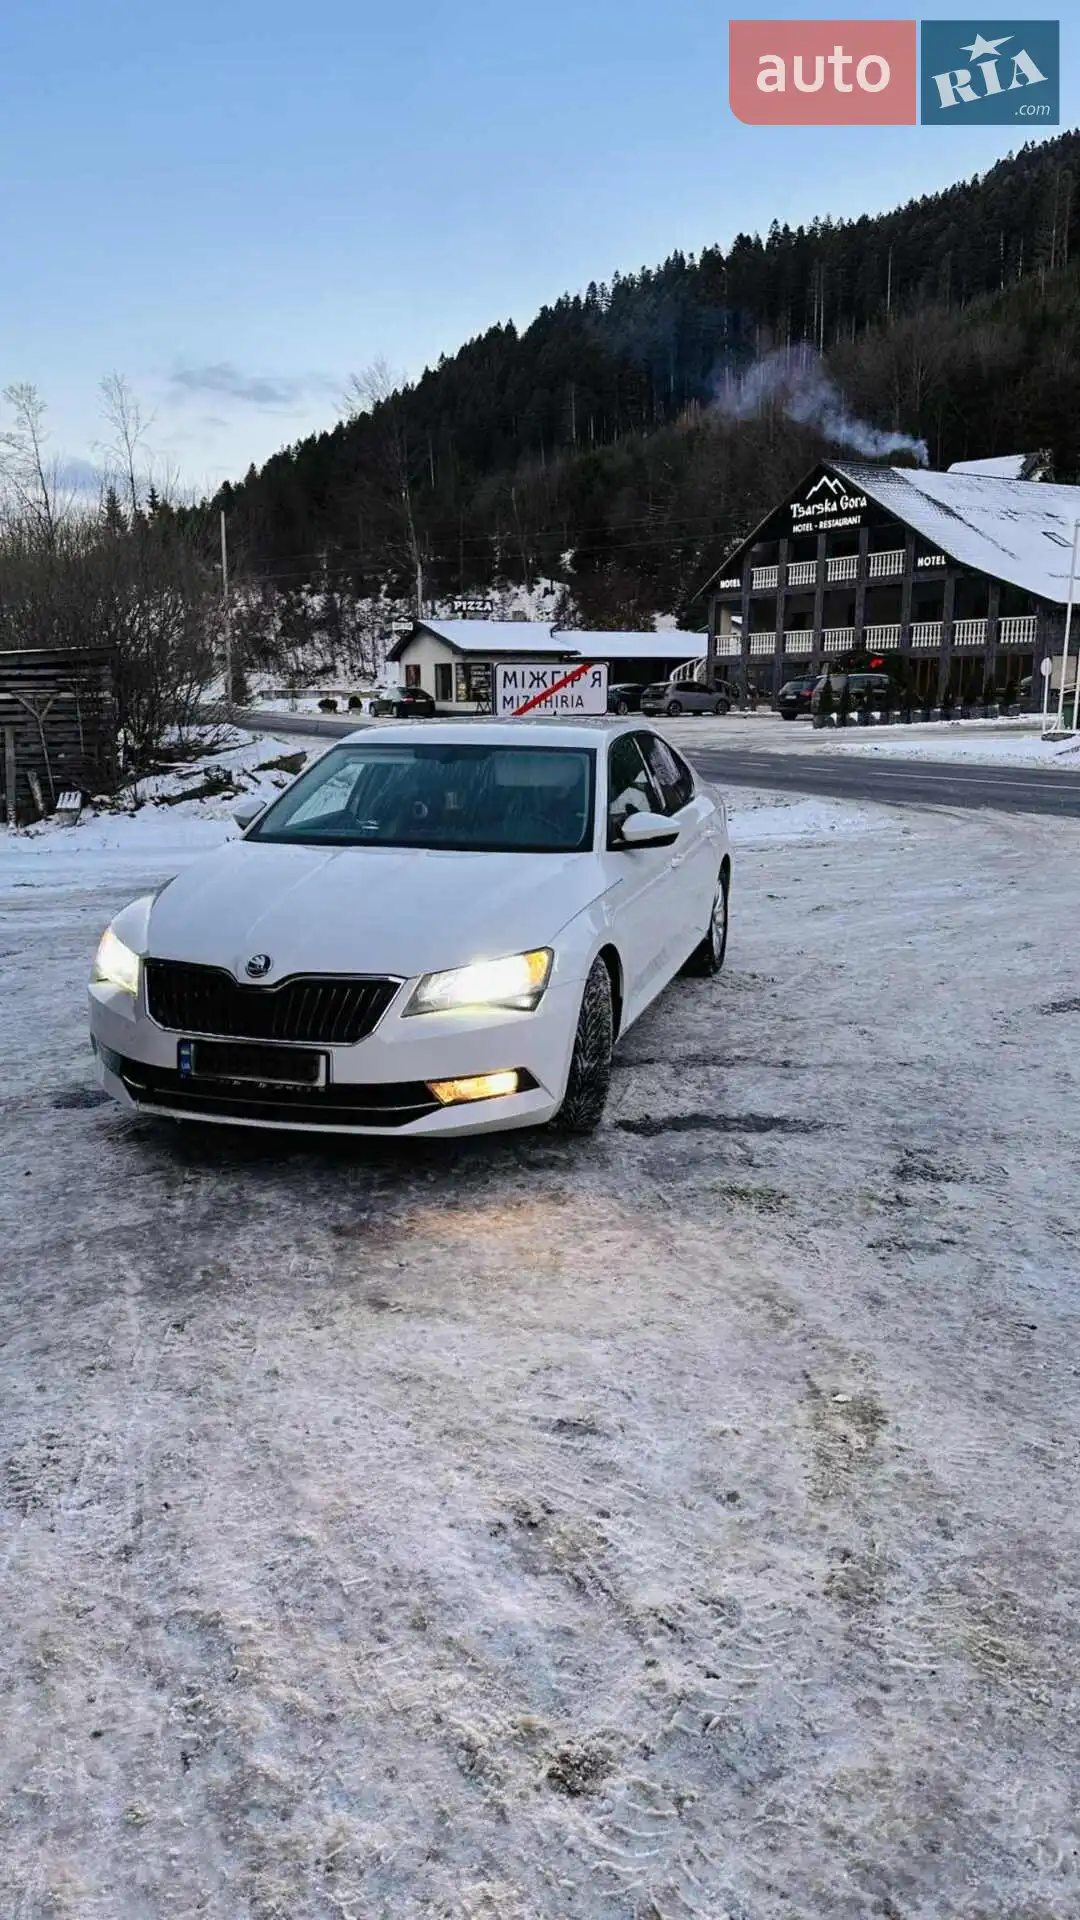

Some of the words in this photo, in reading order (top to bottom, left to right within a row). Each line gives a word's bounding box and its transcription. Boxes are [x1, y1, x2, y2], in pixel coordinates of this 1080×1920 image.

[790, 498, 838, 518] Tsarska
[840, 495, 867, 510] Gora
[793, 522, 813, 533] HOTEL
[819, 515, 861, 529] RESTAURANT
[917, 555, 947, 568] HOTEL
[720, 578, 742, 589] HOTEL
[453, 600, 492, 611] PIZZA
